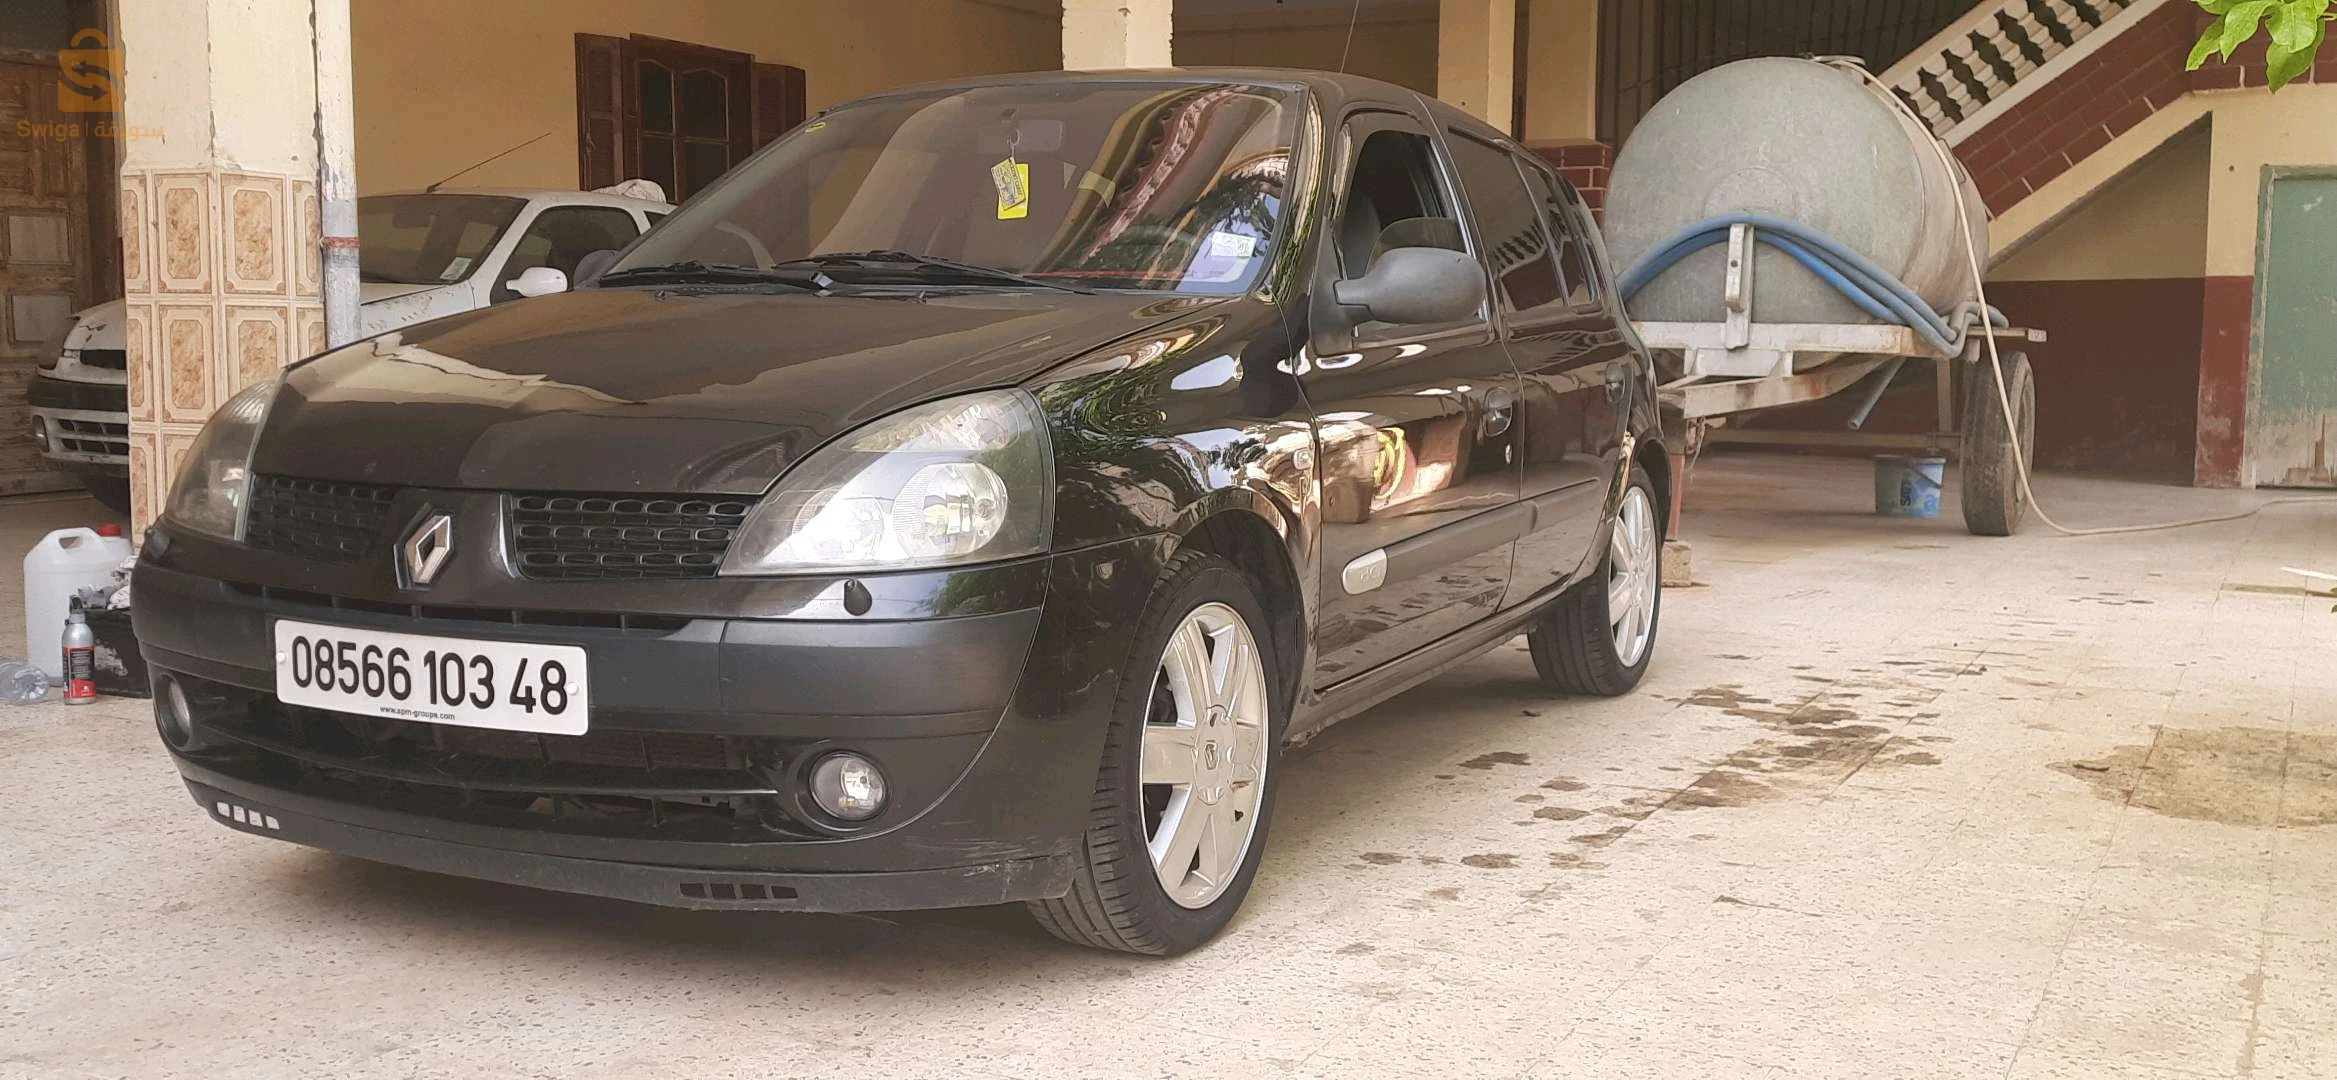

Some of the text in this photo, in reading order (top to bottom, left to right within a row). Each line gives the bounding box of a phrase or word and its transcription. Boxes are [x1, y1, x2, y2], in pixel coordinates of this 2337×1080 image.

[291, 635, 569, 716] 08566 103 48
